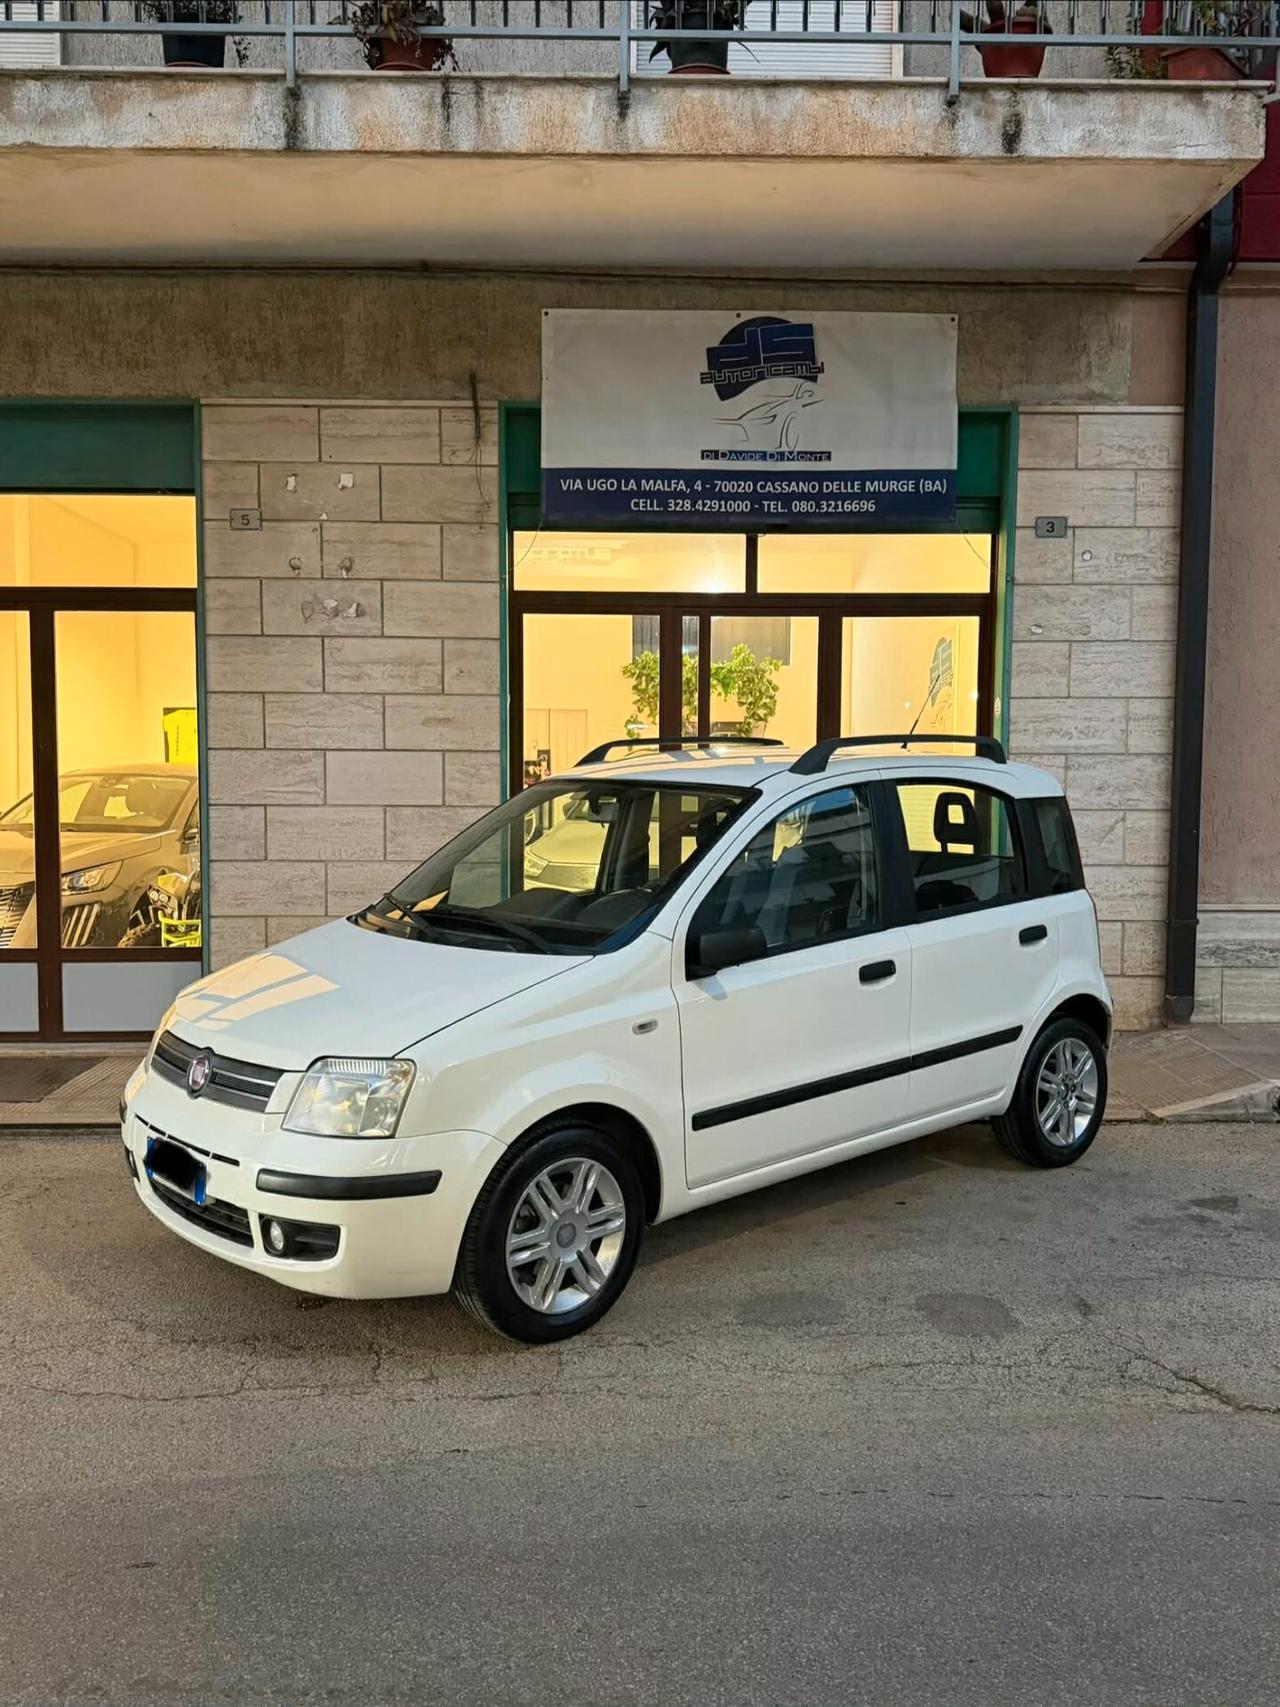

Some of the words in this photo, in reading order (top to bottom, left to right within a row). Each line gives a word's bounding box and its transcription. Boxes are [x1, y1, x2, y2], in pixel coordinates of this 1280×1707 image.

[560, 479, 583, 491] VIA
[587, 479, 617, 491] UGO
[621, 479, 637, 491] LA
[641, 479, 690, 493] MALFA,
[694, 480, 702, 491] 4
[714, 480, 753, 493] 70020
[756, 481, 819, 493] CASSANO
[823, 481, 861, 493] DELLE
[865, 480, 915, 493] MURGE
[919, 478, 947, 494] (BA)
[630, 499, 664, 511] CELL.
[667, 499, 750, 512] 328.4291000
[762, 501, 788, 512] TEL.
[792, 500, 876, 513] 080.3216696
[241, 514, 250, 526] 5
[1046, 521, 1055, 533] 3
